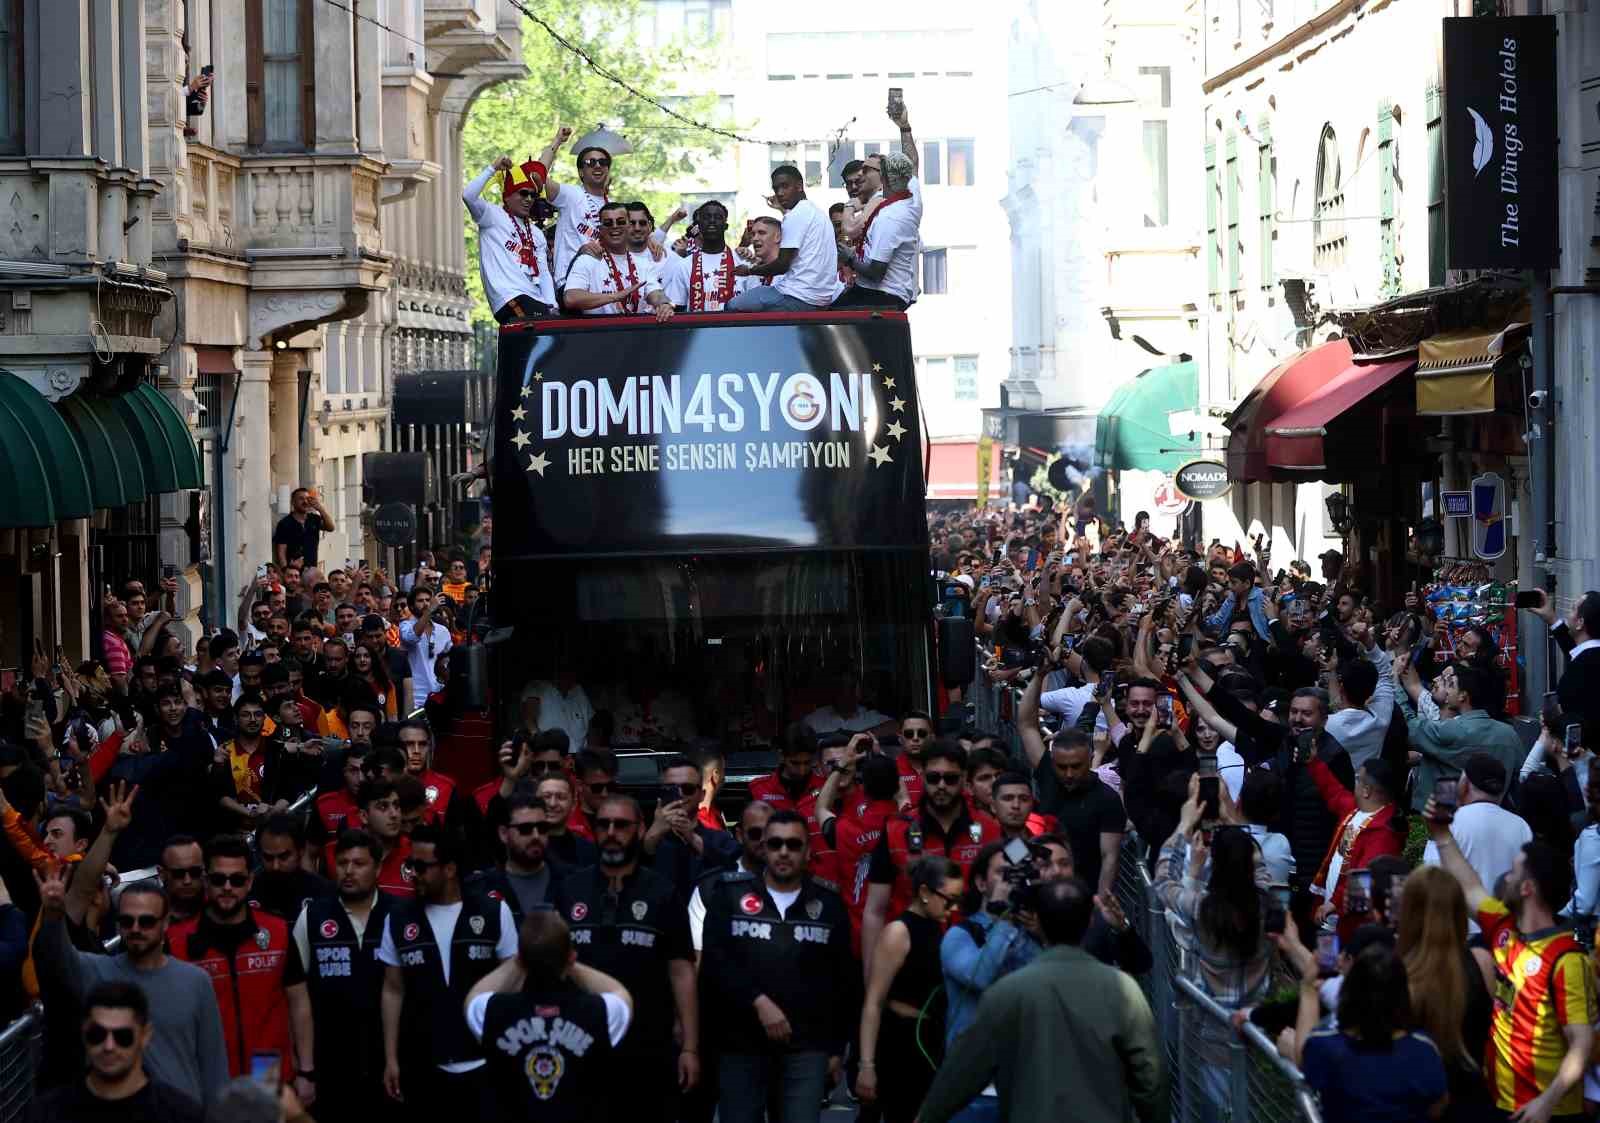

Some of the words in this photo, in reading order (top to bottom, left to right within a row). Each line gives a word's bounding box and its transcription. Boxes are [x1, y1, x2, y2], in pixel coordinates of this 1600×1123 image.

[1499, 37, 1517, 113] Hotels
[1501, 123, 1523, 194] Wings
[1501, 203, 1519, 247] The
[568, 446, 605, 475] HER
[610, 444, 660, 473] SENE
[1181, 472, 1228, 482] NOMADS
[731, 920, 772, 940] SPOR
[315, 946, 351, 962] SPOR
